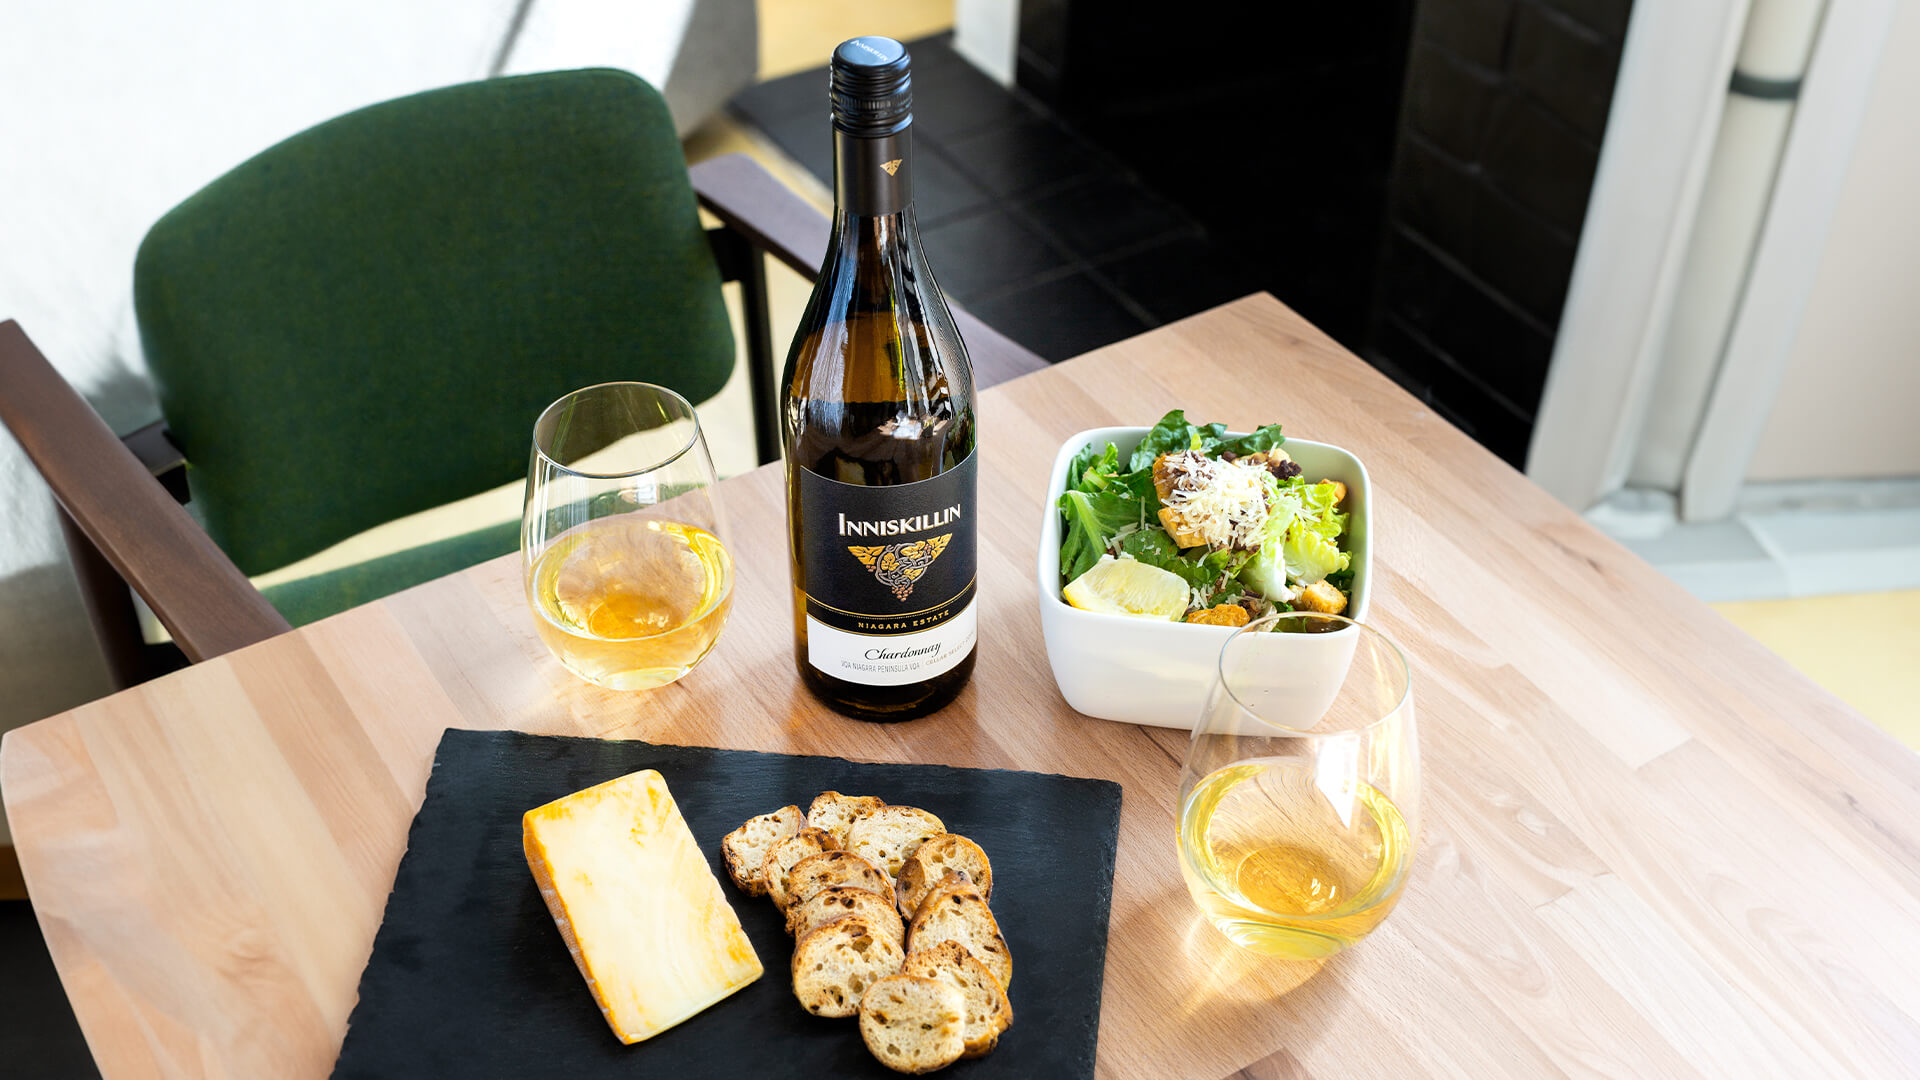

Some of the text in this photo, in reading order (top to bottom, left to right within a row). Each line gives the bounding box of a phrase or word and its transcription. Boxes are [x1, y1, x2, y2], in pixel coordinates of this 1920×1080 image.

[838, 503, 961, 537] INNISKILLIN
[858, 610, 949, 630] NIAGARA ESTATE
[864, 642, 941, 660] Chardonnay
[852, 662, 877, 673] NIAGARA
[877, 664, 909, 673] PENINSULA
